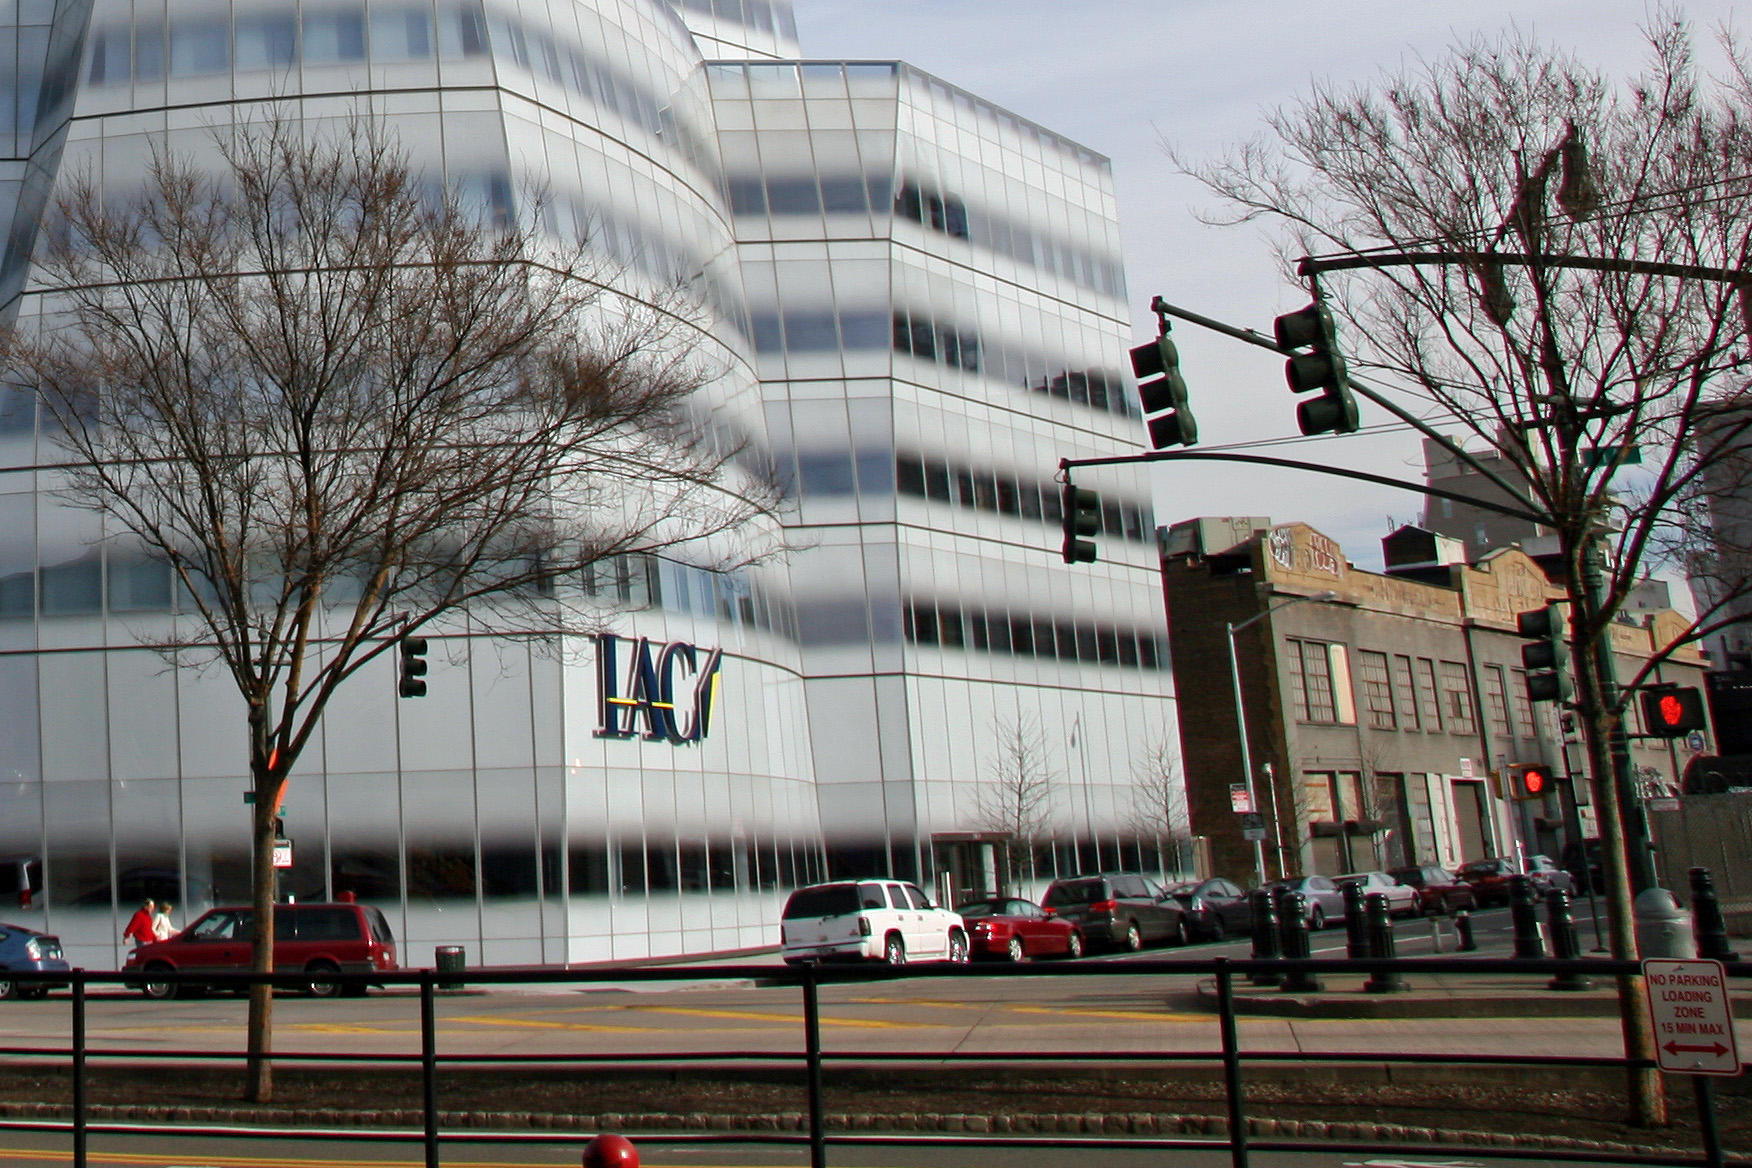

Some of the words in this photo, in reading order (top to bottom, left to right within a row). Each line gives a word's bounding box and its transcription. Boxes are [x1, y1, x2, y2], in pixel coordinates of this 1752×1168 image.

[1649, 974, 1666, 986] NO
[1669, 974, 1720, 987] PARKING
[1662, 990, 1713, 1003] LOADING
[1673, 1006, 1705, 1019] ZONE
[1661, 1022, 1673, 1033] 15
[1676, 1022, 1697, 1034] MIN
[1699, 1023, 1725, 1035] MAX
